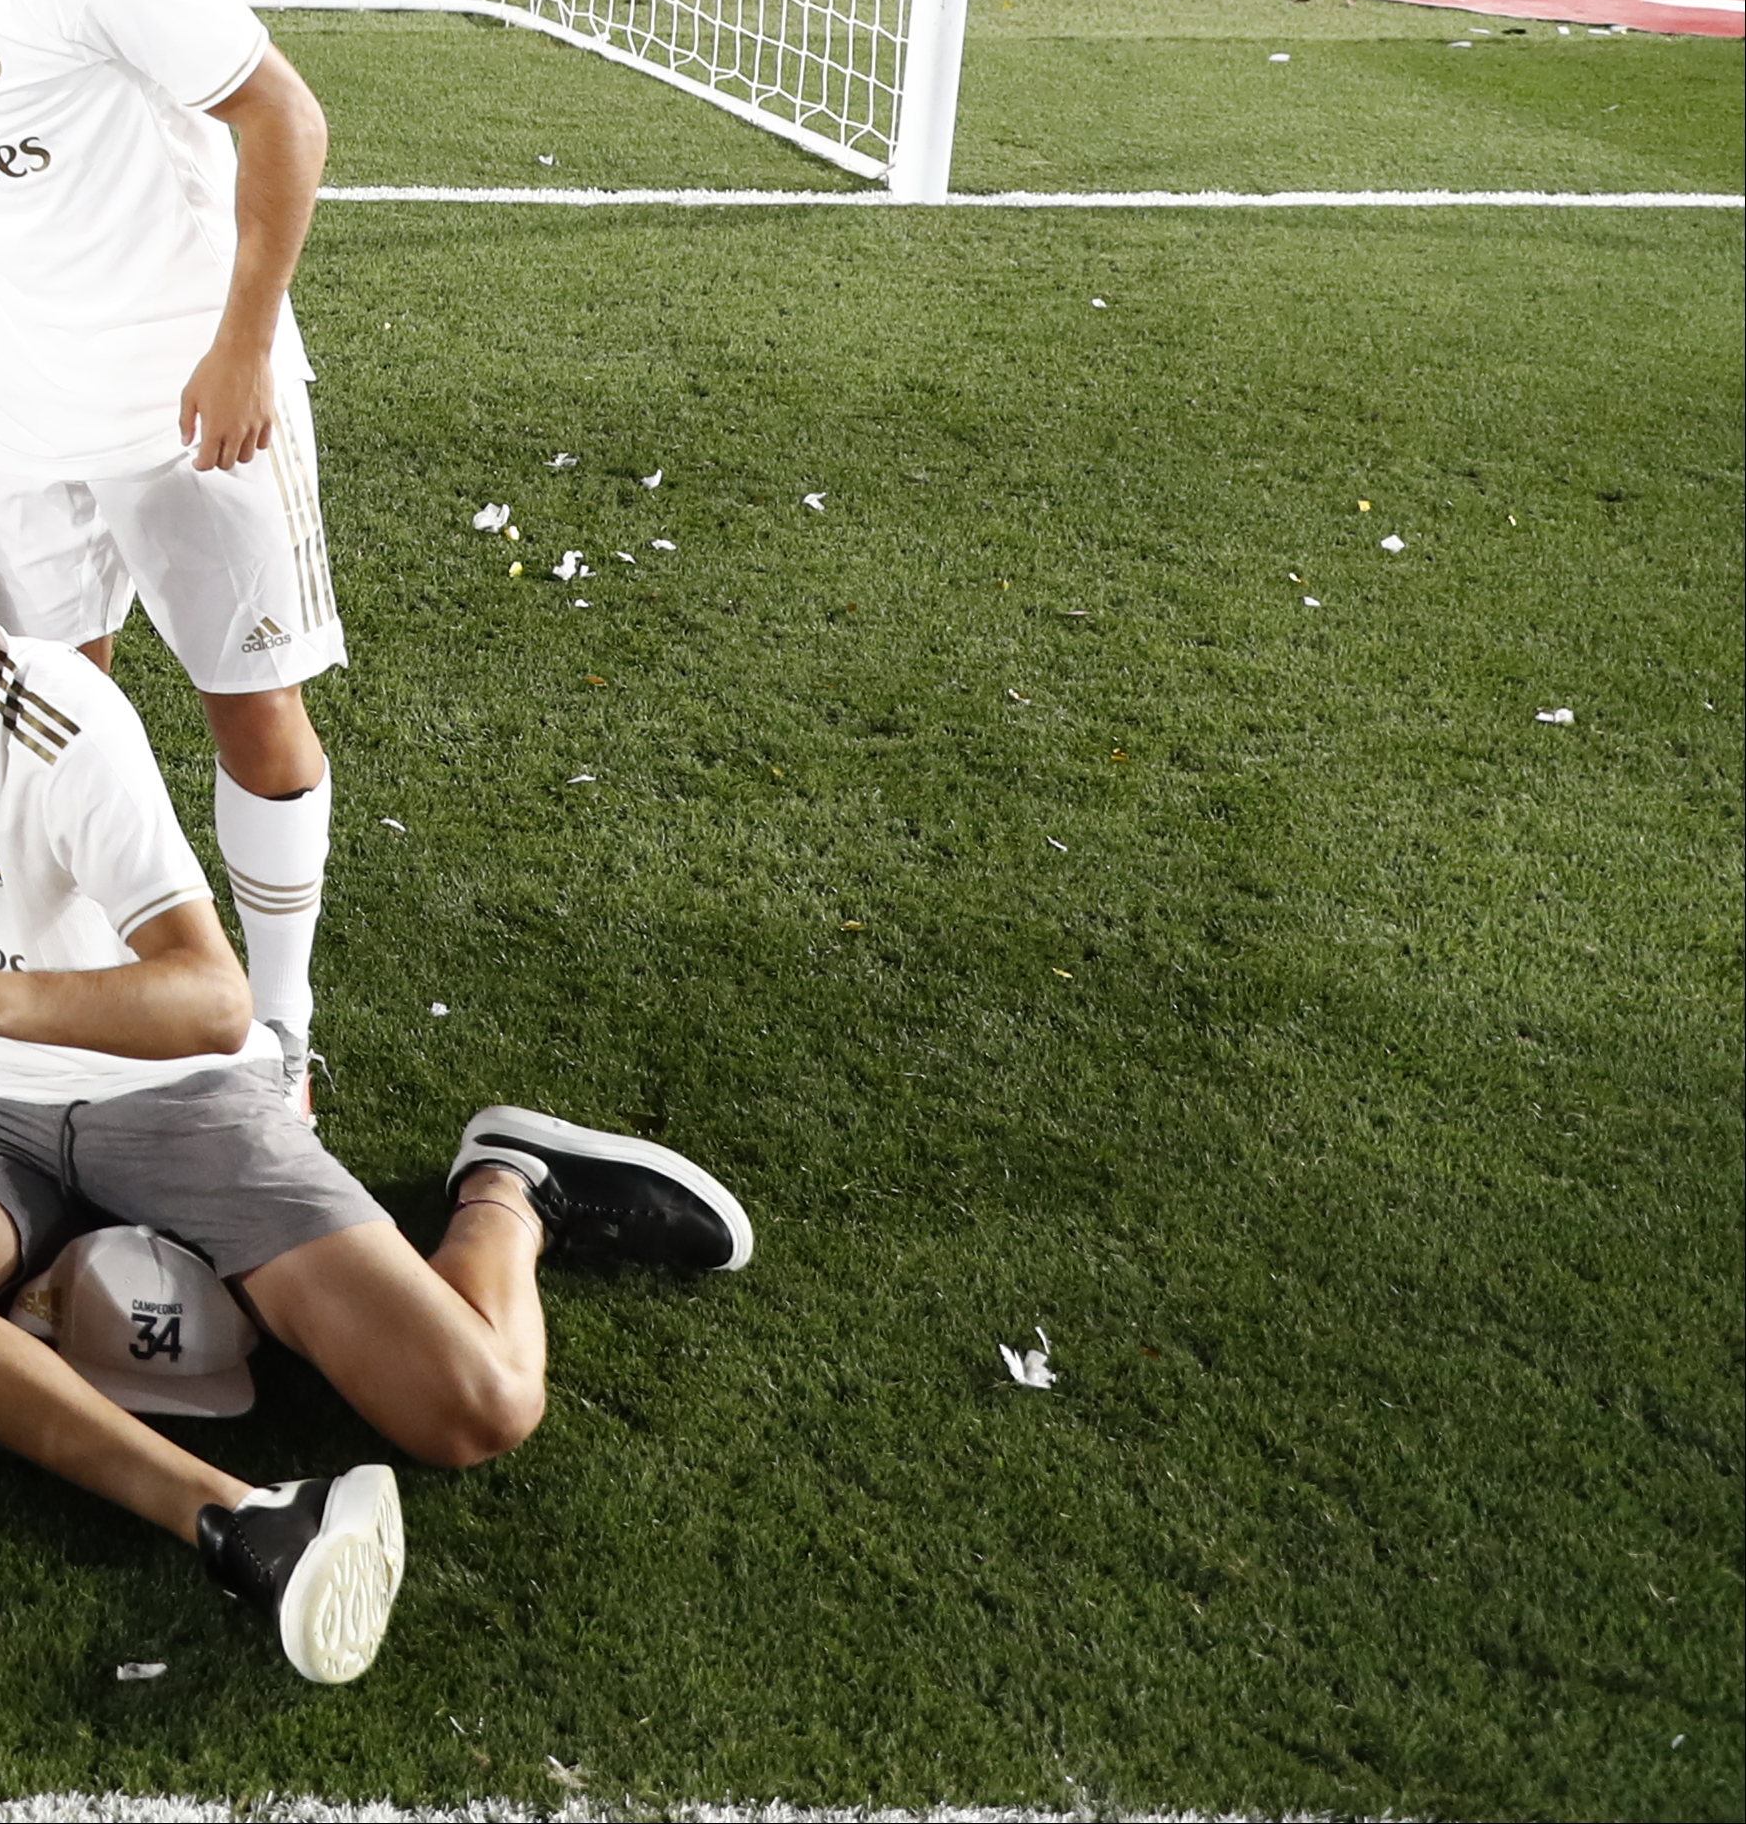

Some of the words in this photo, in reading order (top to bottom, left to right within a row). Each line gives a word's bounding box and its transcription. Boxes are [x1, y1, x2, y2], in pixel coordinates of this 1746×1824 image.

[241, 633, 292, 653] adidas
[132, 1299, 184, 1315] CAMPEONES
[129, 1313, 183, 1363] 34
